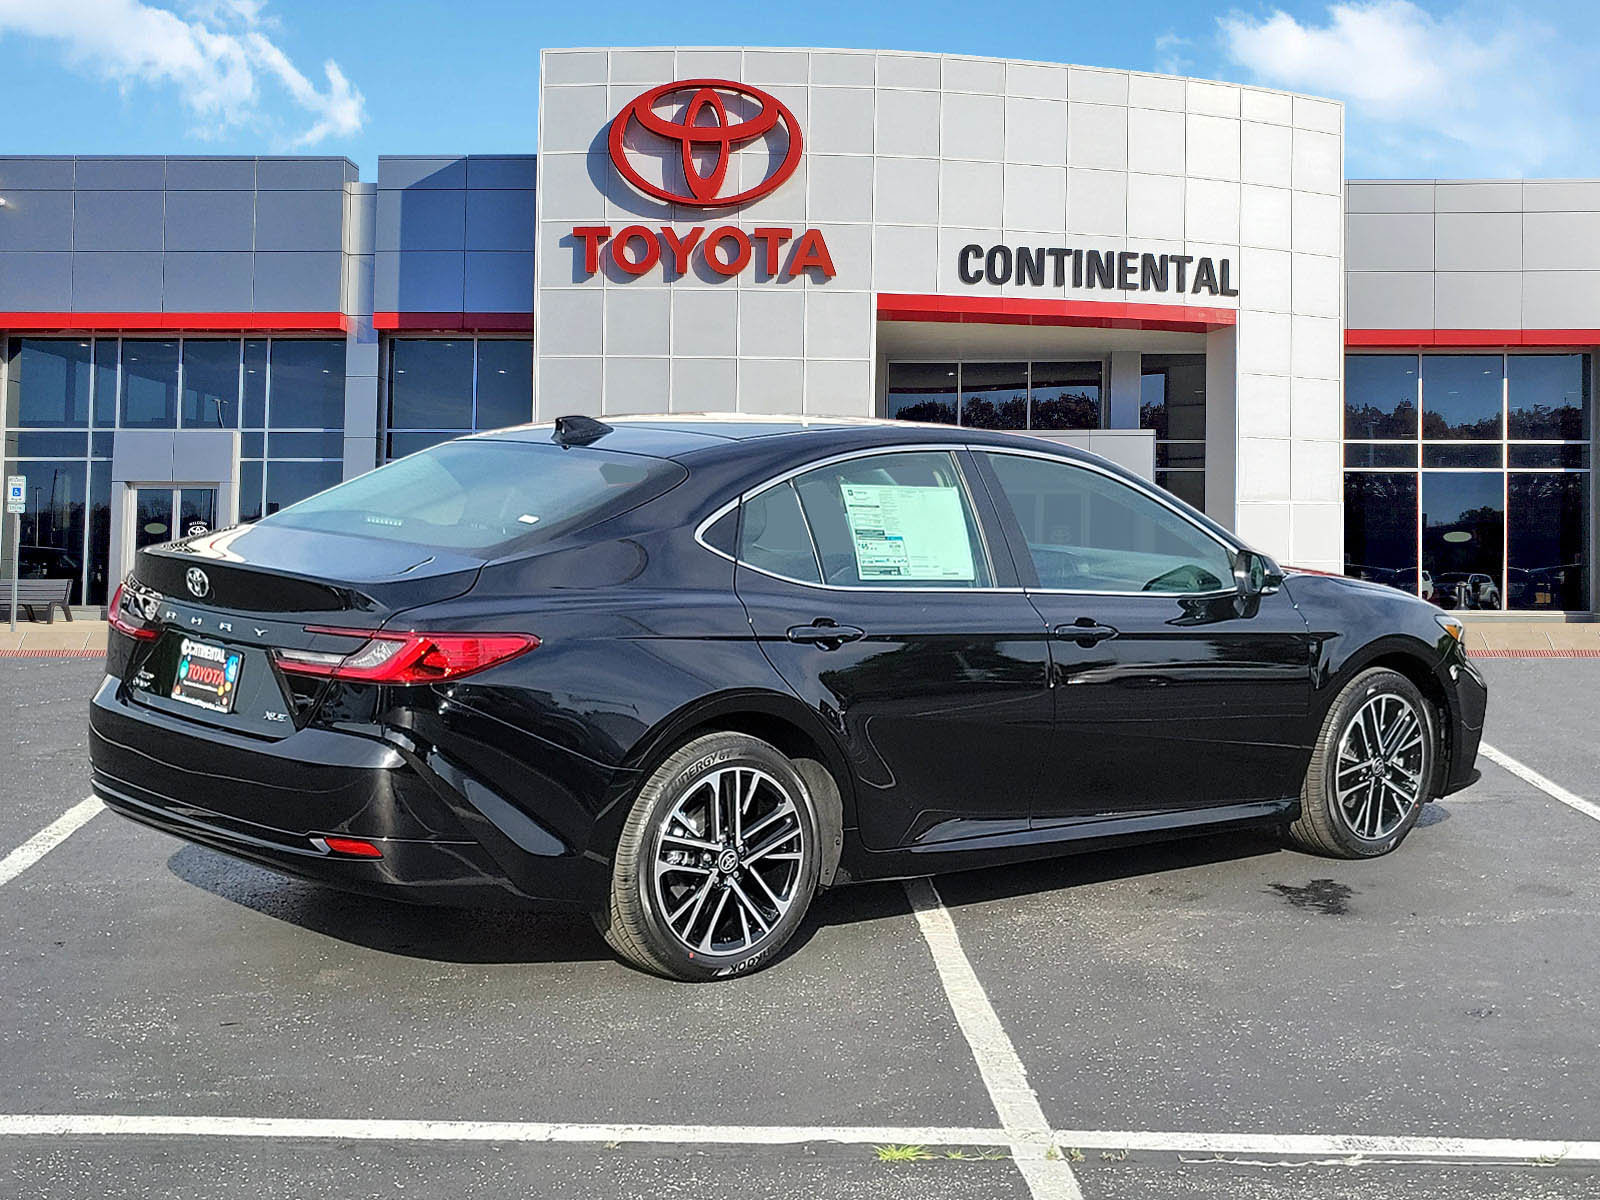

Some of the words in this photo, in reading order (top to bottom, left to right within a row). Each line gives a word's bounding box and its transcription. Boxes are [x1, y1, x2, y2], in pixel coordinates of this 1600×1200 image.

[573, 226, 836, 279] TOYOTA
[958, 243, 1239, 296] CONTINENTAL
[152, 607, 268, 636] AMRY
[187, 663, 225, 685] TOYOTA
[264, 711, 288, 722] XLE
